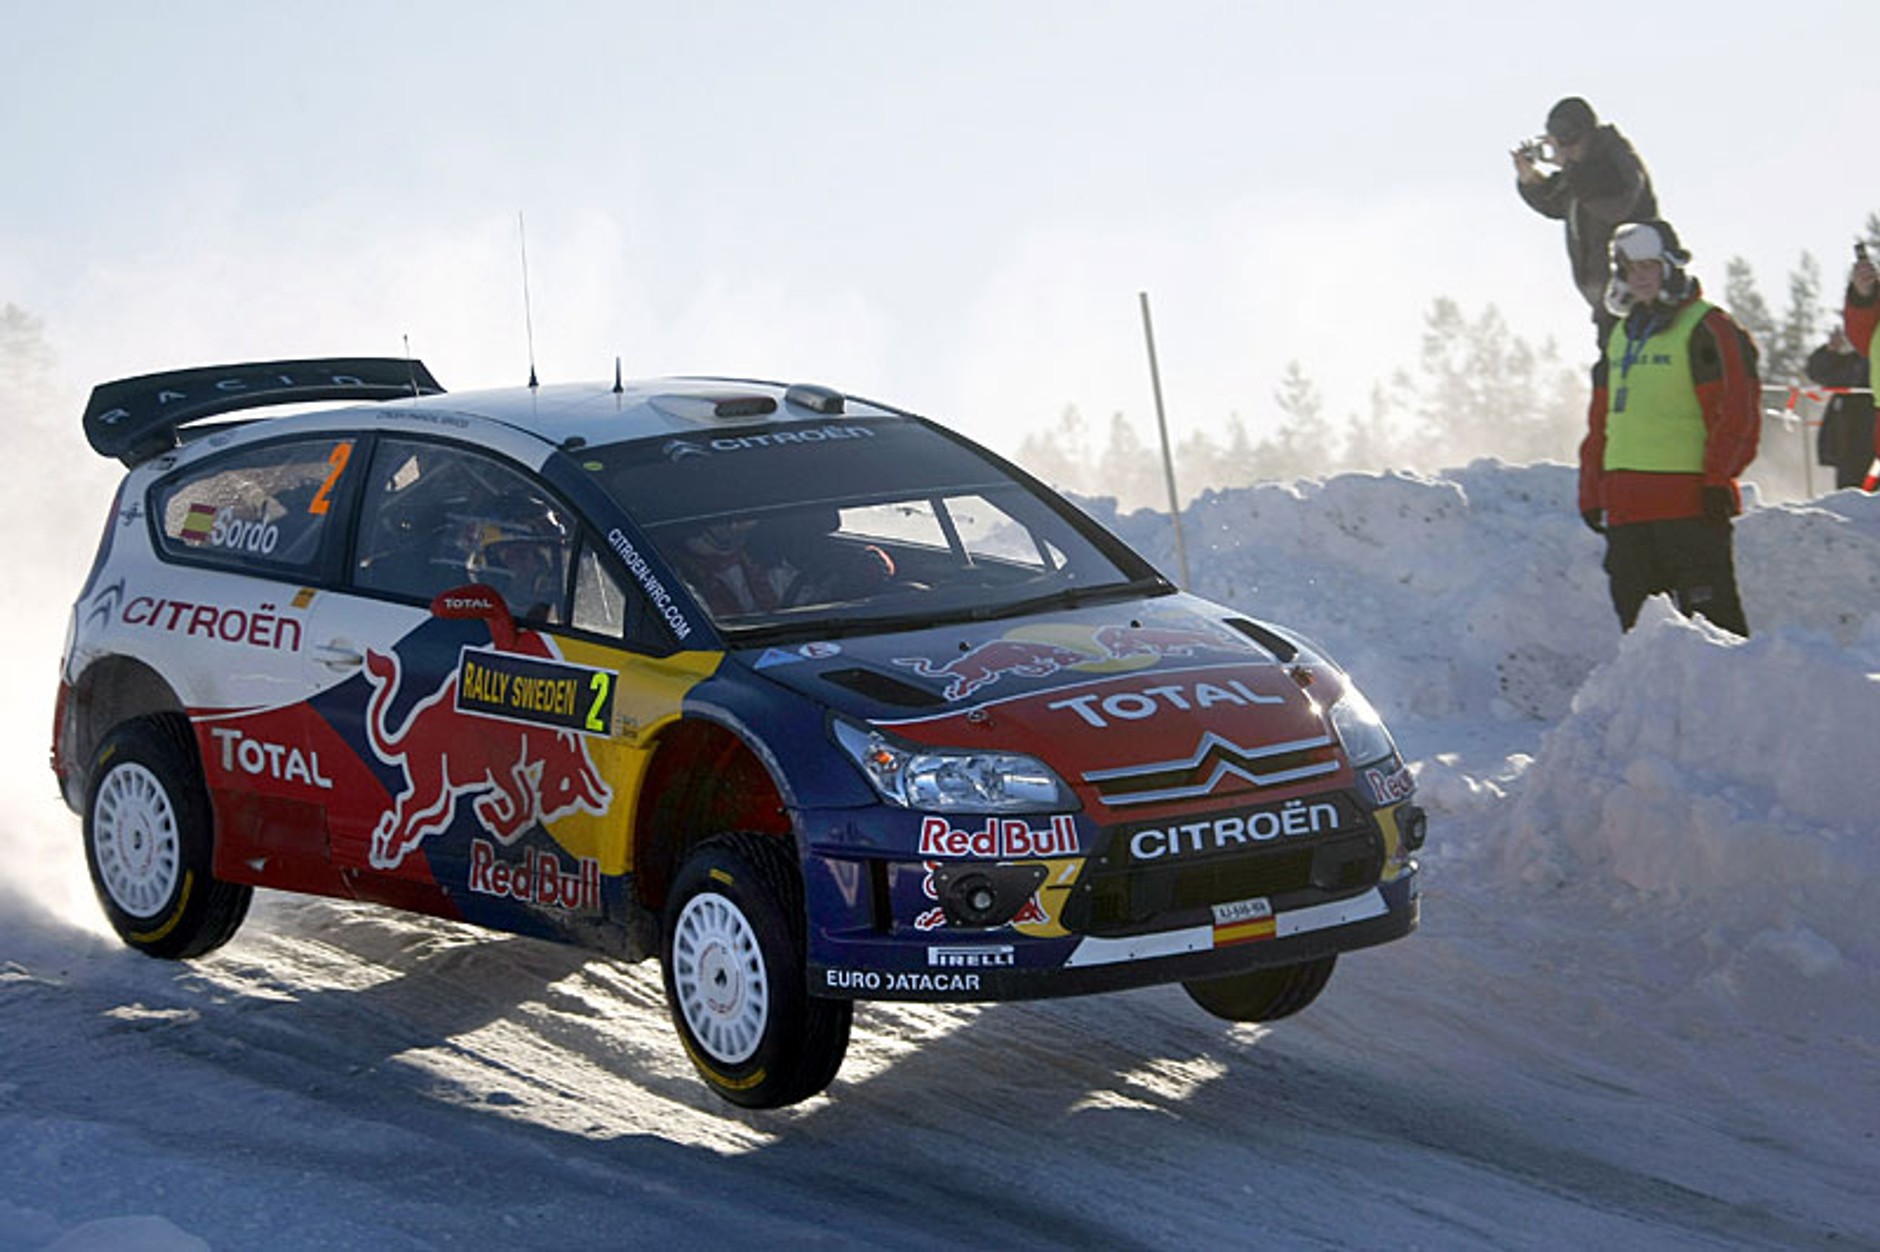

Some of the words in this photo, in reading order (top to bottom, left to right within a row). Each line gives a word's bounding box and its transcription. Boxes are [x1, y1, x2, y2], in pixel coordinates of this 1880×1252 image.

[307, 440, 353, 514] 2
[210, 509, 279, 554] Sordo
[443, 598, 494, 609] TOTAL
[463, 662, 511, 704] RALLY
[511, 676, 578, 716] SWEDEN
[585, 672, 609, 731] 2
[1050, 680, 1284, 727] TOTAL
[211, 728, 332, 788] TOTAL
[919, 816, 999, 857] Red
[1000, 816, 1080, 856] Bull
[469, 838, 533, 900] Red
[537, 853, 601, 914] Bull
[826, 969, 881, 989] EURO
[927, 946, 1015, 967] PIRELLI
